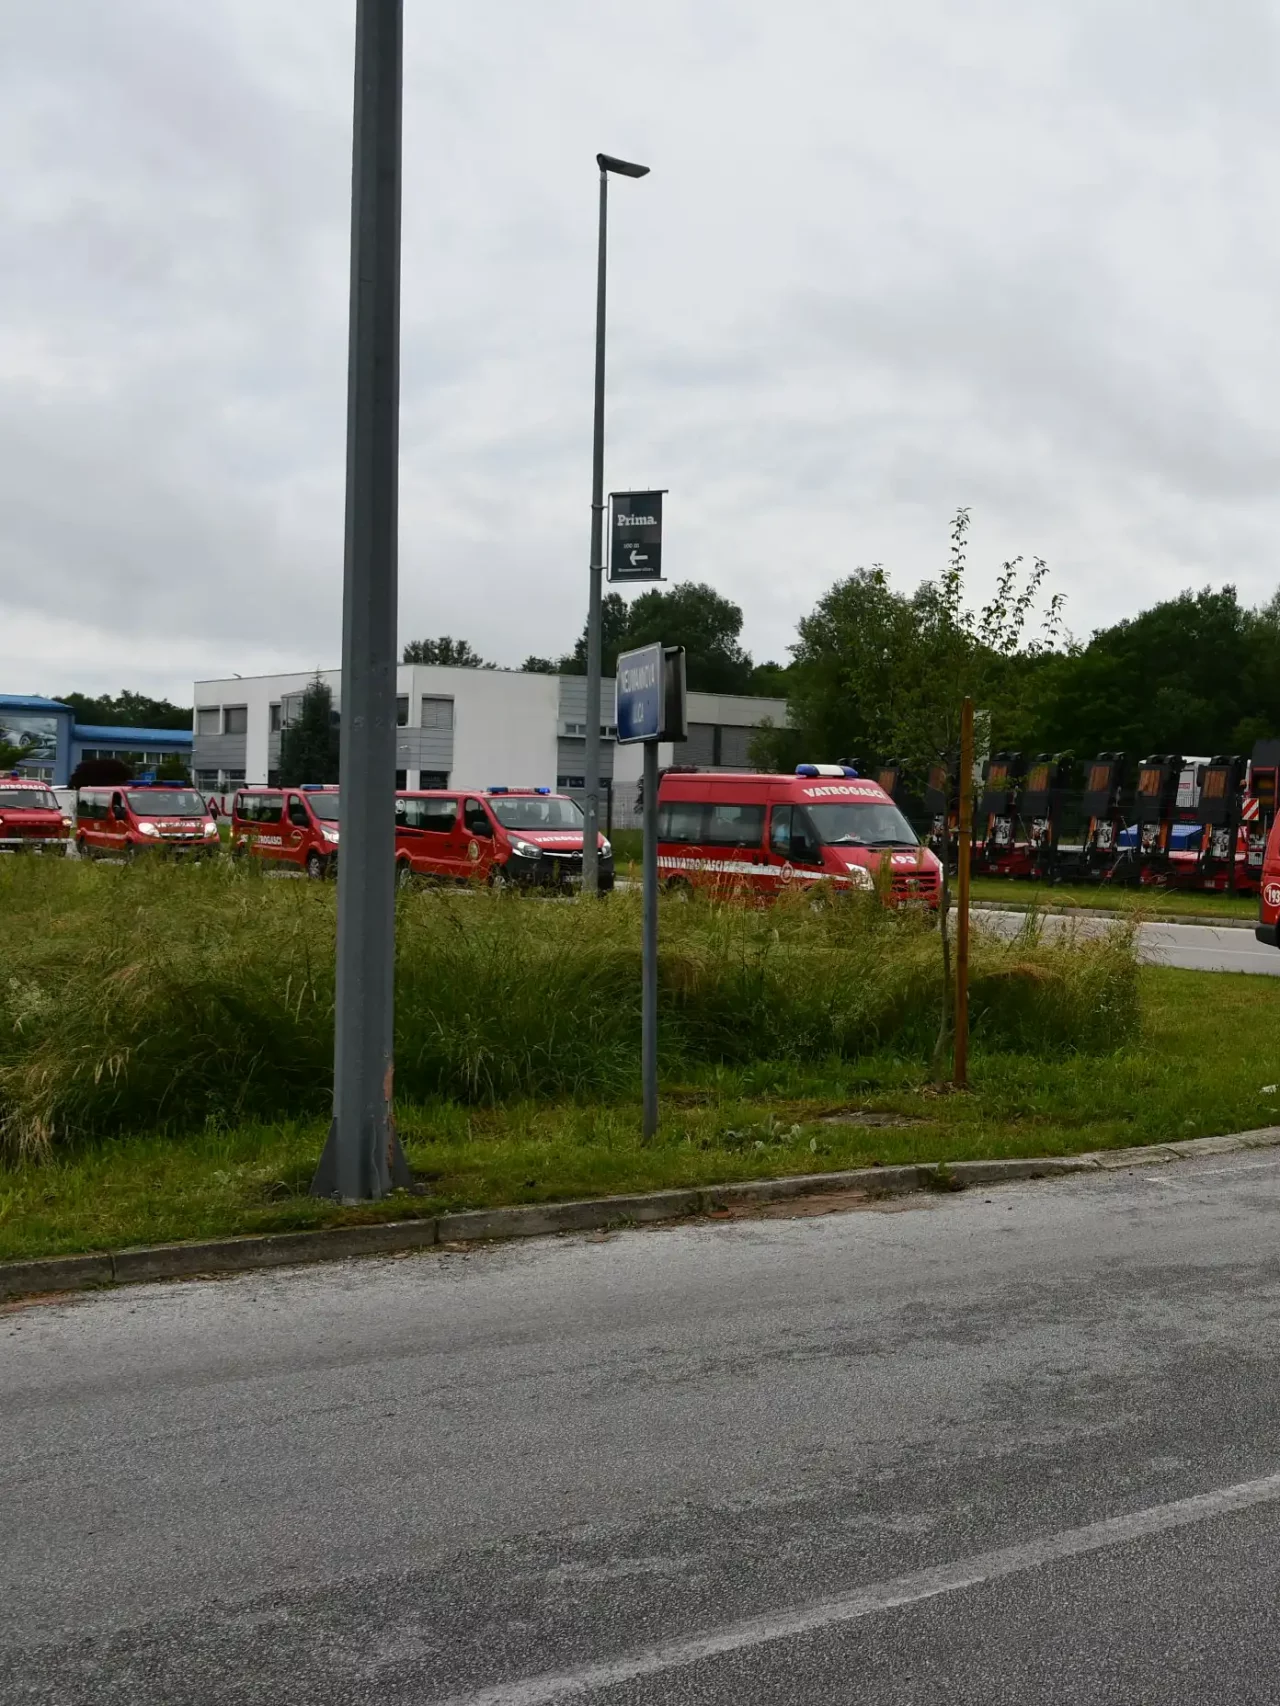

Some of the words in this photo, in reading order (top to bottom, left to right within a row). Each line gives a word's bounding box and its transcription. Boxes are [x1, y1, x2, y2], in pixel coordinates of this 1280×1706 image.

[617, 514, 657, 526] Prima.
[803, 786, 886, 799] VATROGASCI
[534, 835, 584, 843] VATROGA
[1267, 886, 1280, 903] 193
